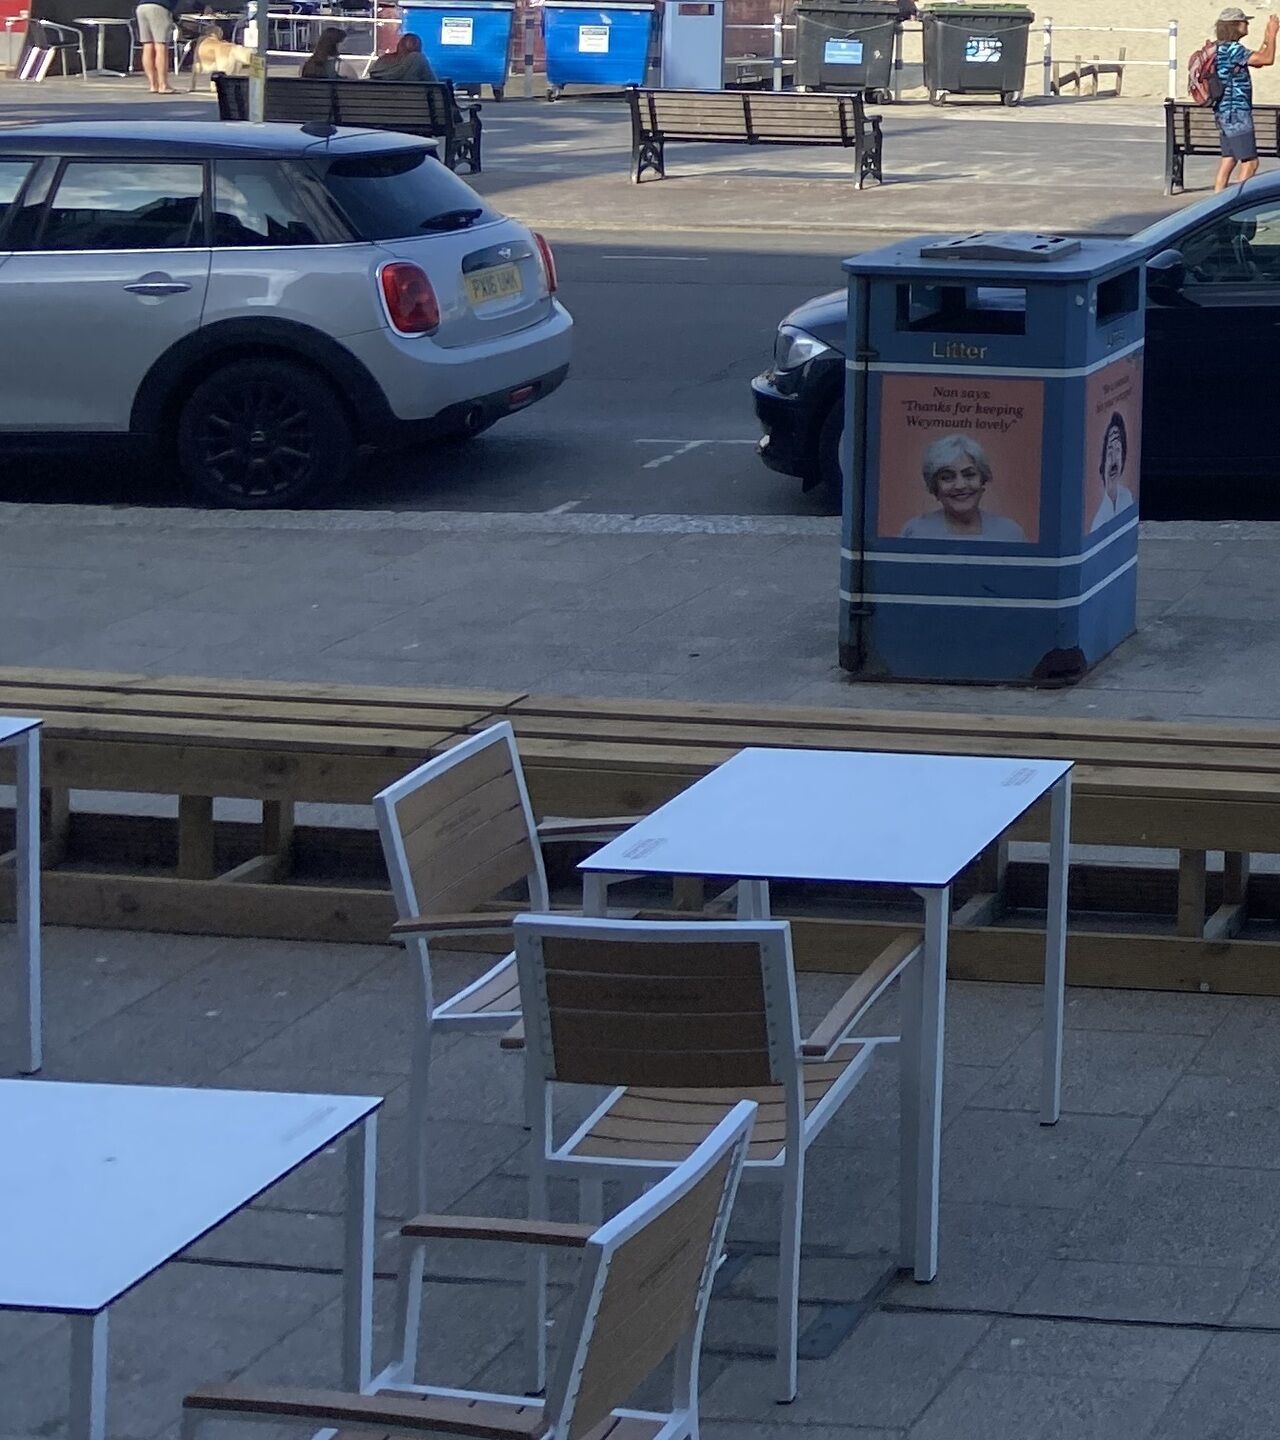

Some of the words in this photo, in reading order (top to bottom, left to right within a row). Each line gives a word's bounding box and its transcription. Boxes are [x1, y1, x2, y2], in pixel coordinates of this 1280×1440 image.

[932, 341, 988, 359] Litter
[933, 386, 959, 398] Nan
[952, 402, 972, 416] for
[975, 402, 1024, 418] keeping
[906, 415, 972, 430] Weymouth
